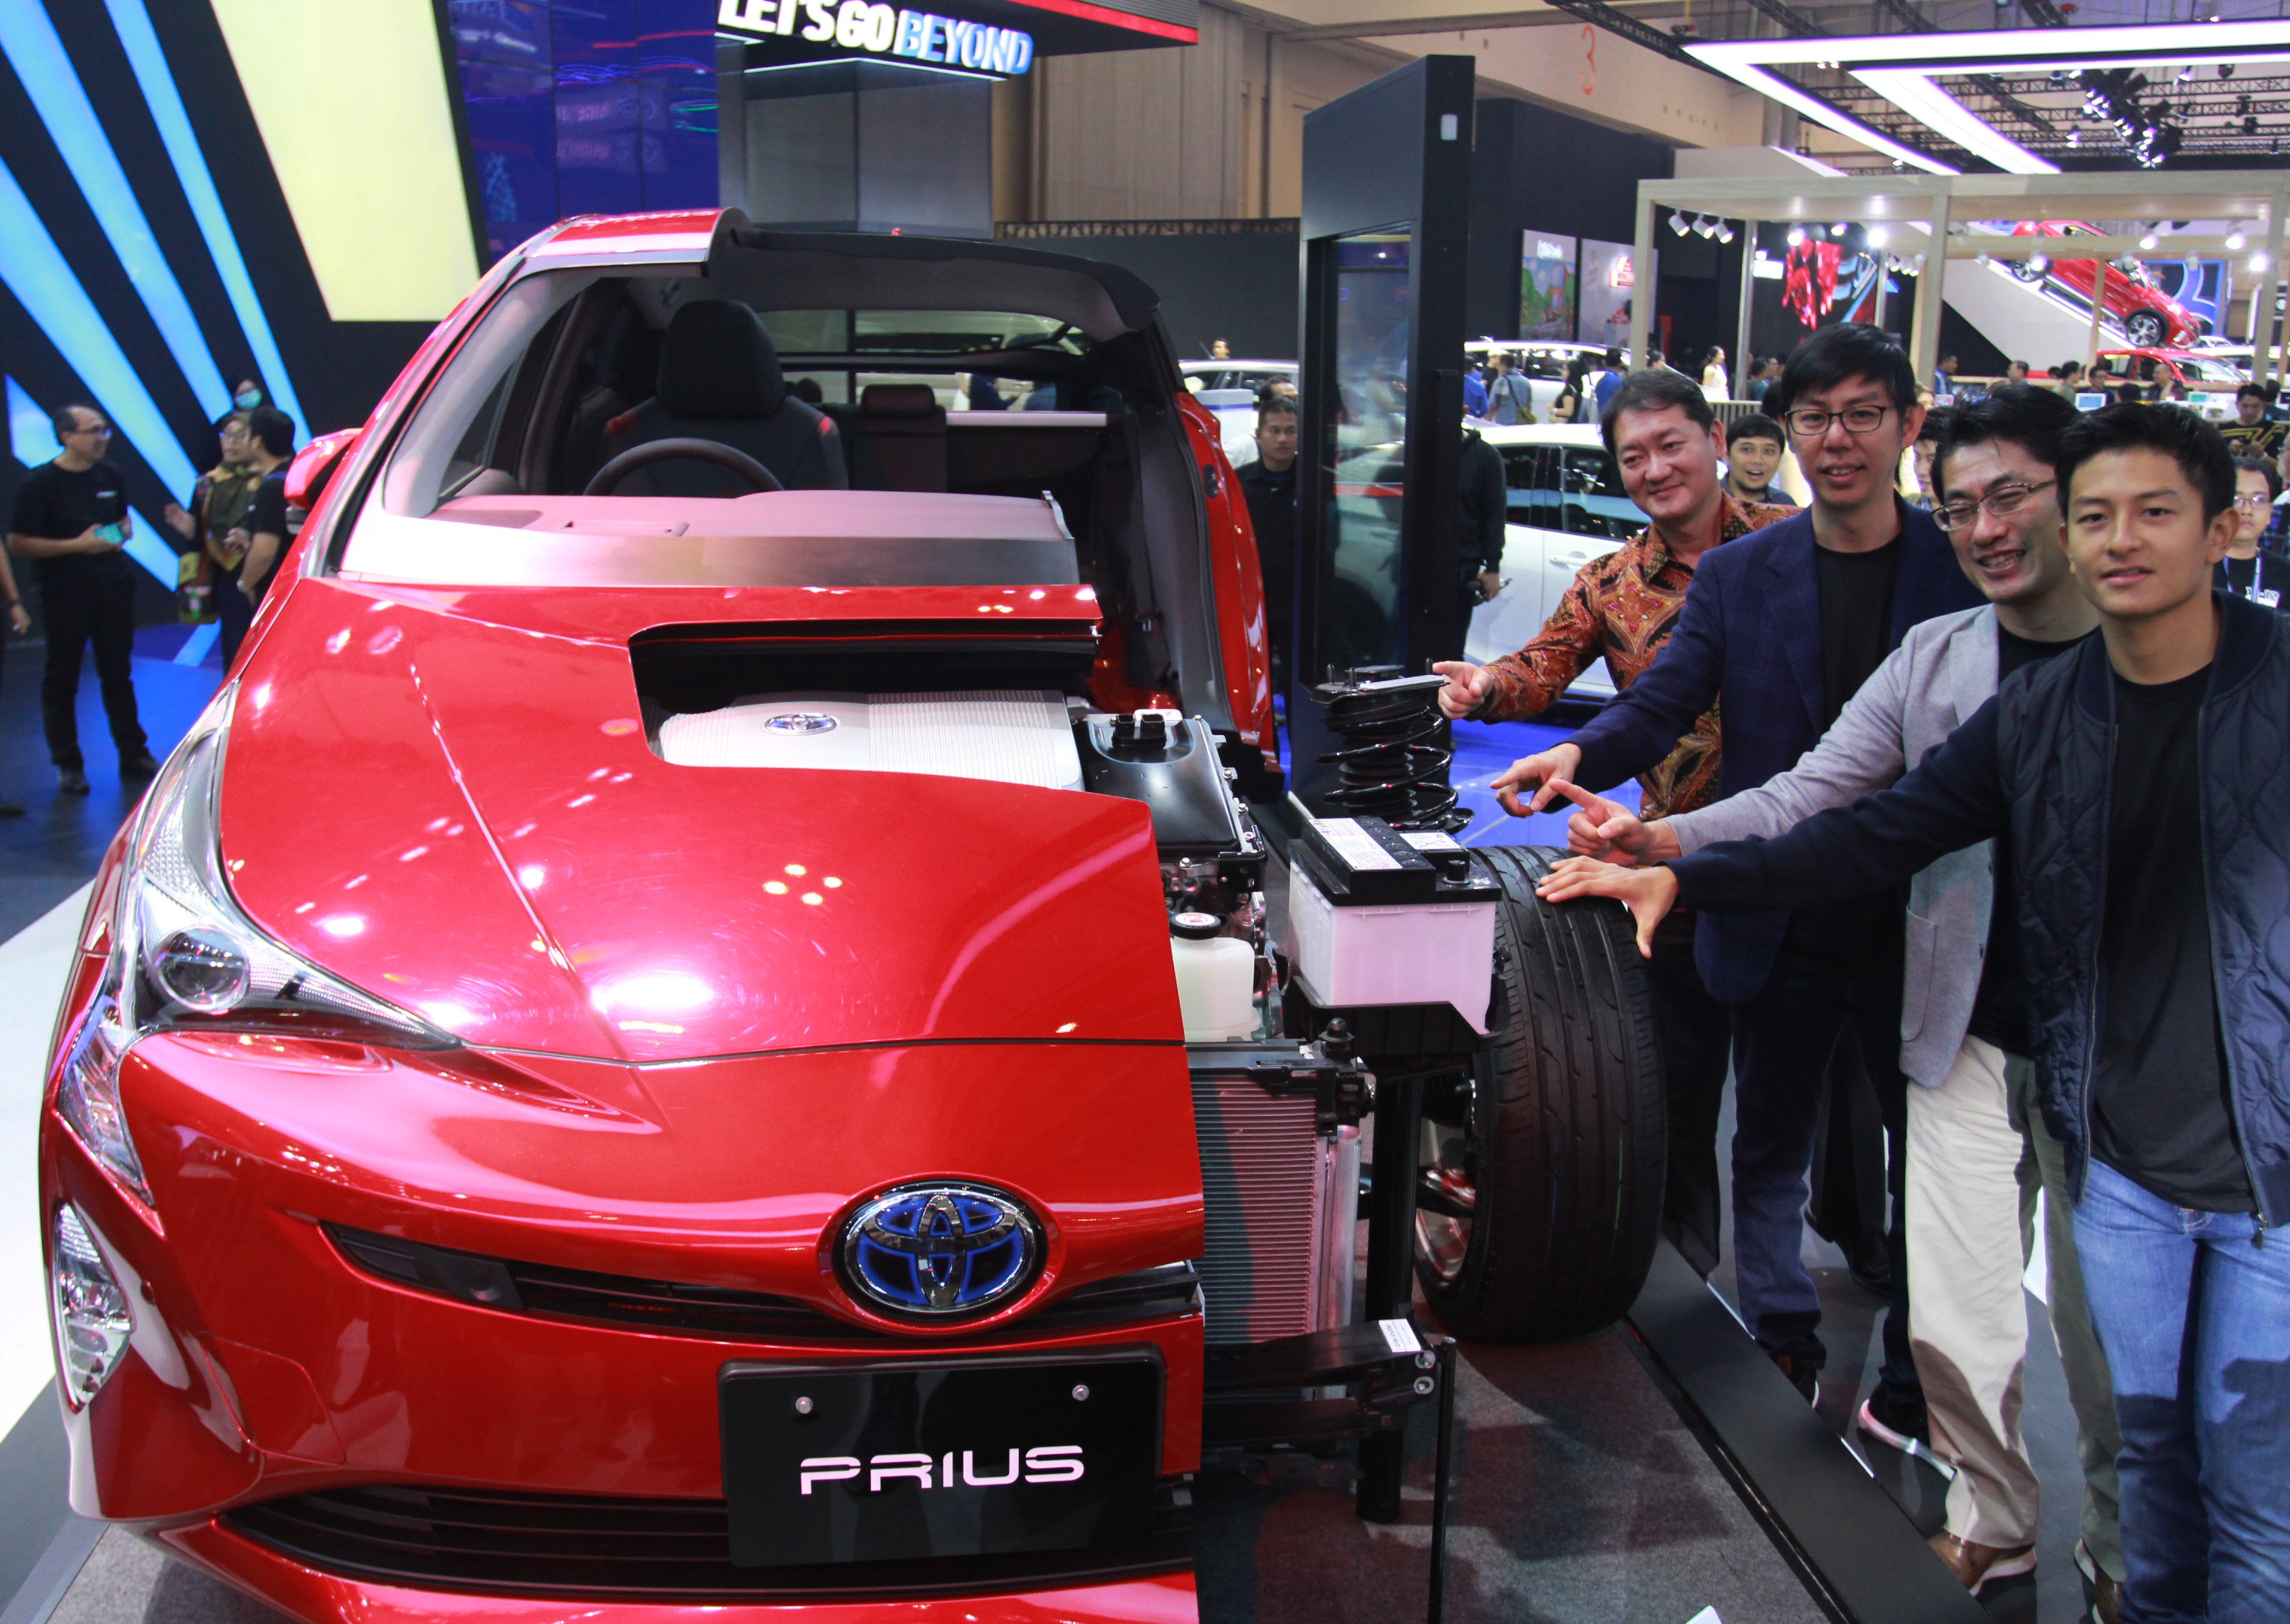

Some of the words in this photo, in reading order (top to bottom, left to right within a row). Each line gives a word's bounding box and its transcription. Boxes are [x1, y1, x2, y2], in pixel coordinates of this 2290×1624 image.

[717, 0, 835, 41] LETS
[836, 0, 896, 52] GO
[892, 9, 1034, 74] BEYOND
[801, 1445, 1084, 1495] PRIUS
